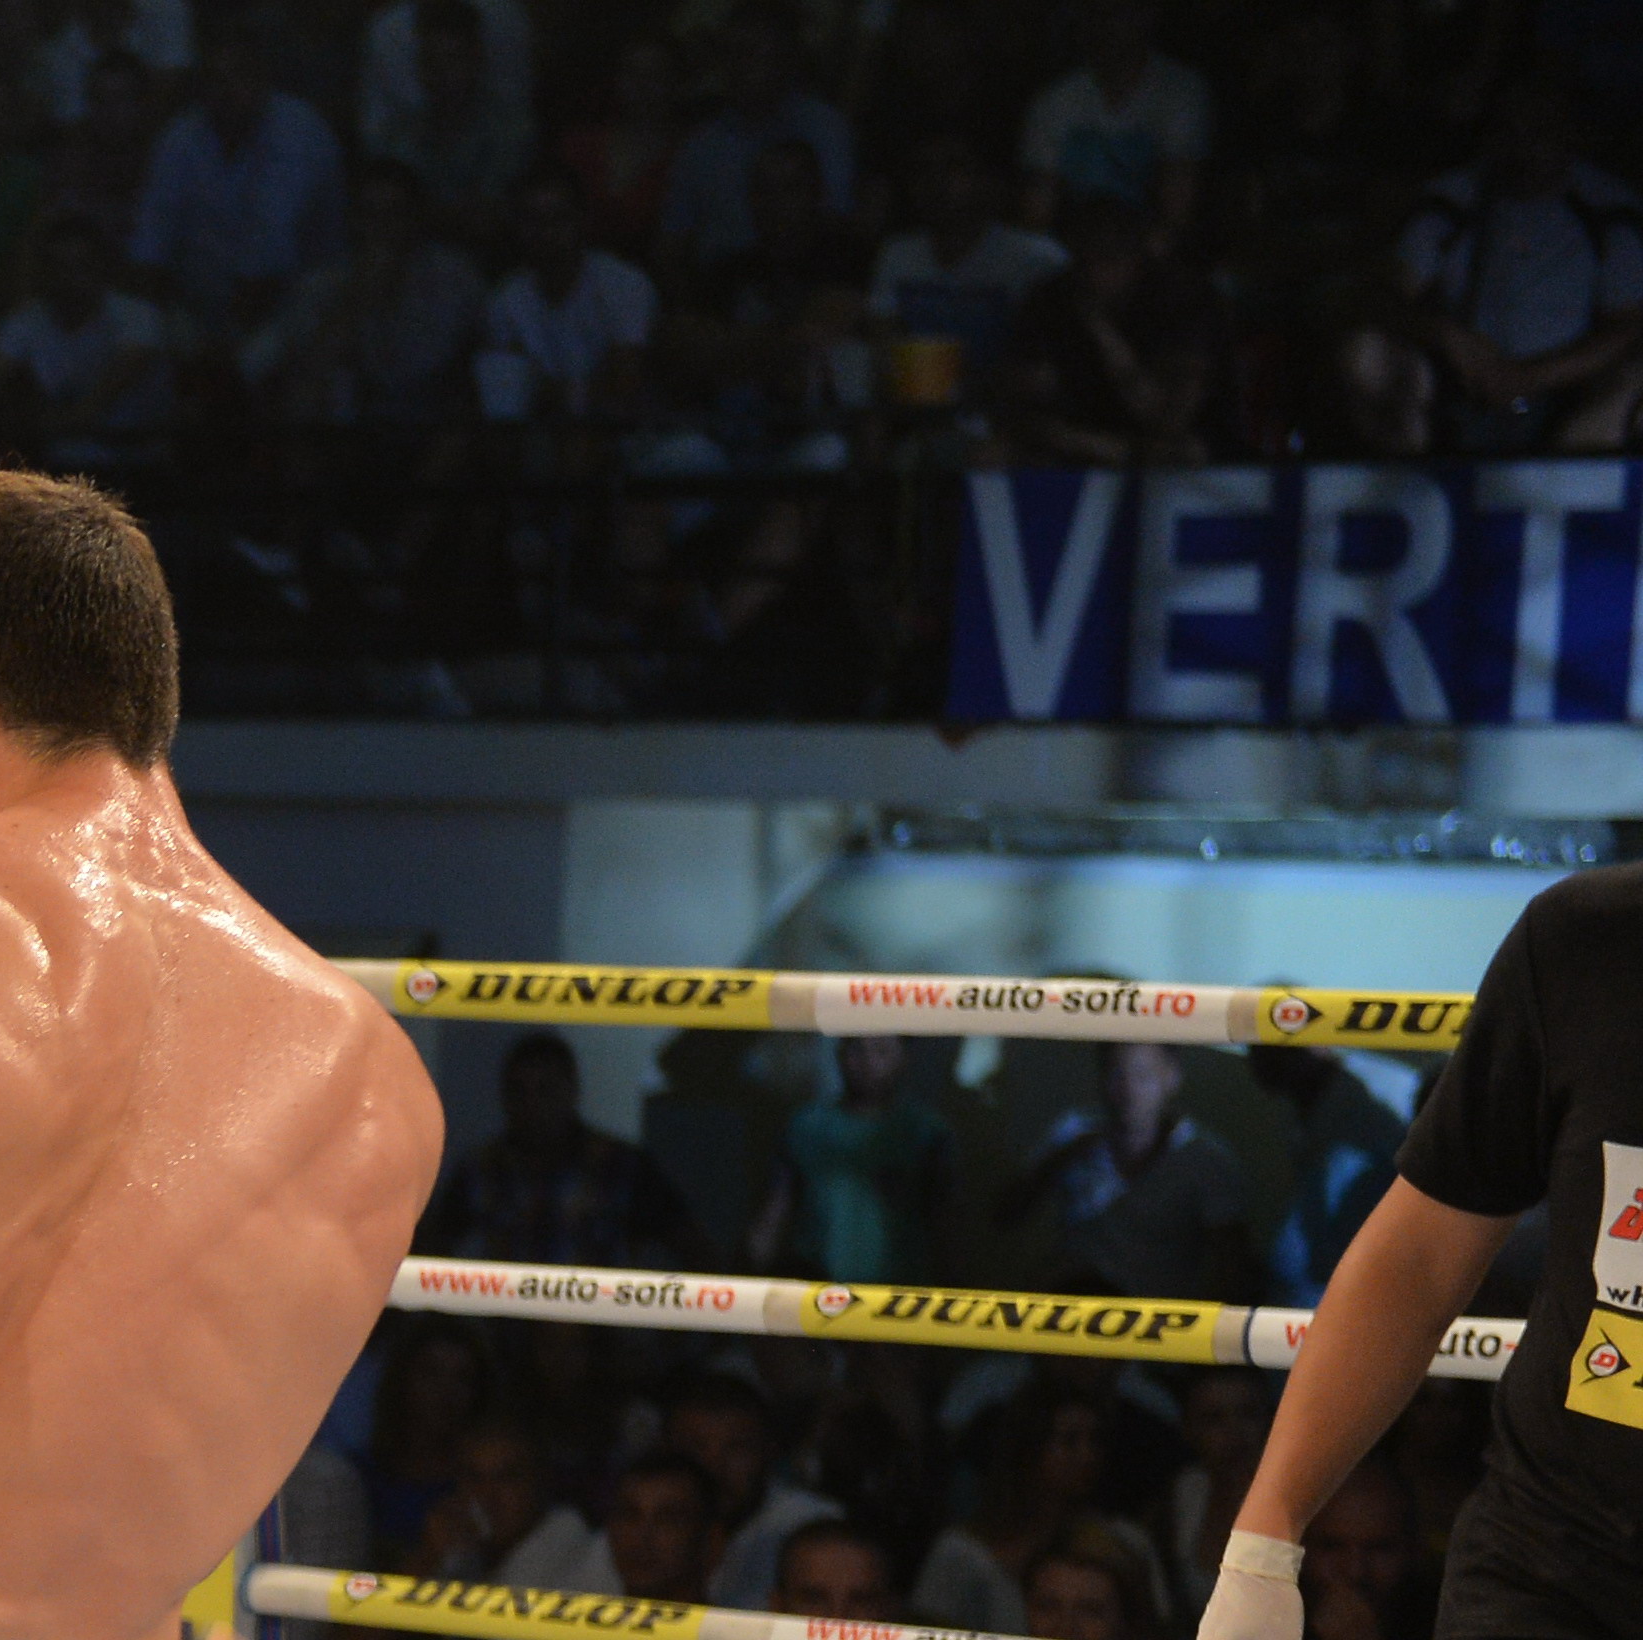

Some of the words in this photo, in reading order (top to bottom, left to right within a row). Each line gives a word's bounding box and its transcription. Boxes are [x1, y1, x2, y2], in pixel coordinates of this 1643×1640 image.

[465, 973, 757, 1011] DUNLOP
[847, 977, 1197, 1021] www.auto-soft.ro
[419, 1263, 735, 1312] www.auto-soft.ro
[872, 1285, 1200, 1344] DUNLOP
[392, 1578, 690, 1634] DUNLOP
